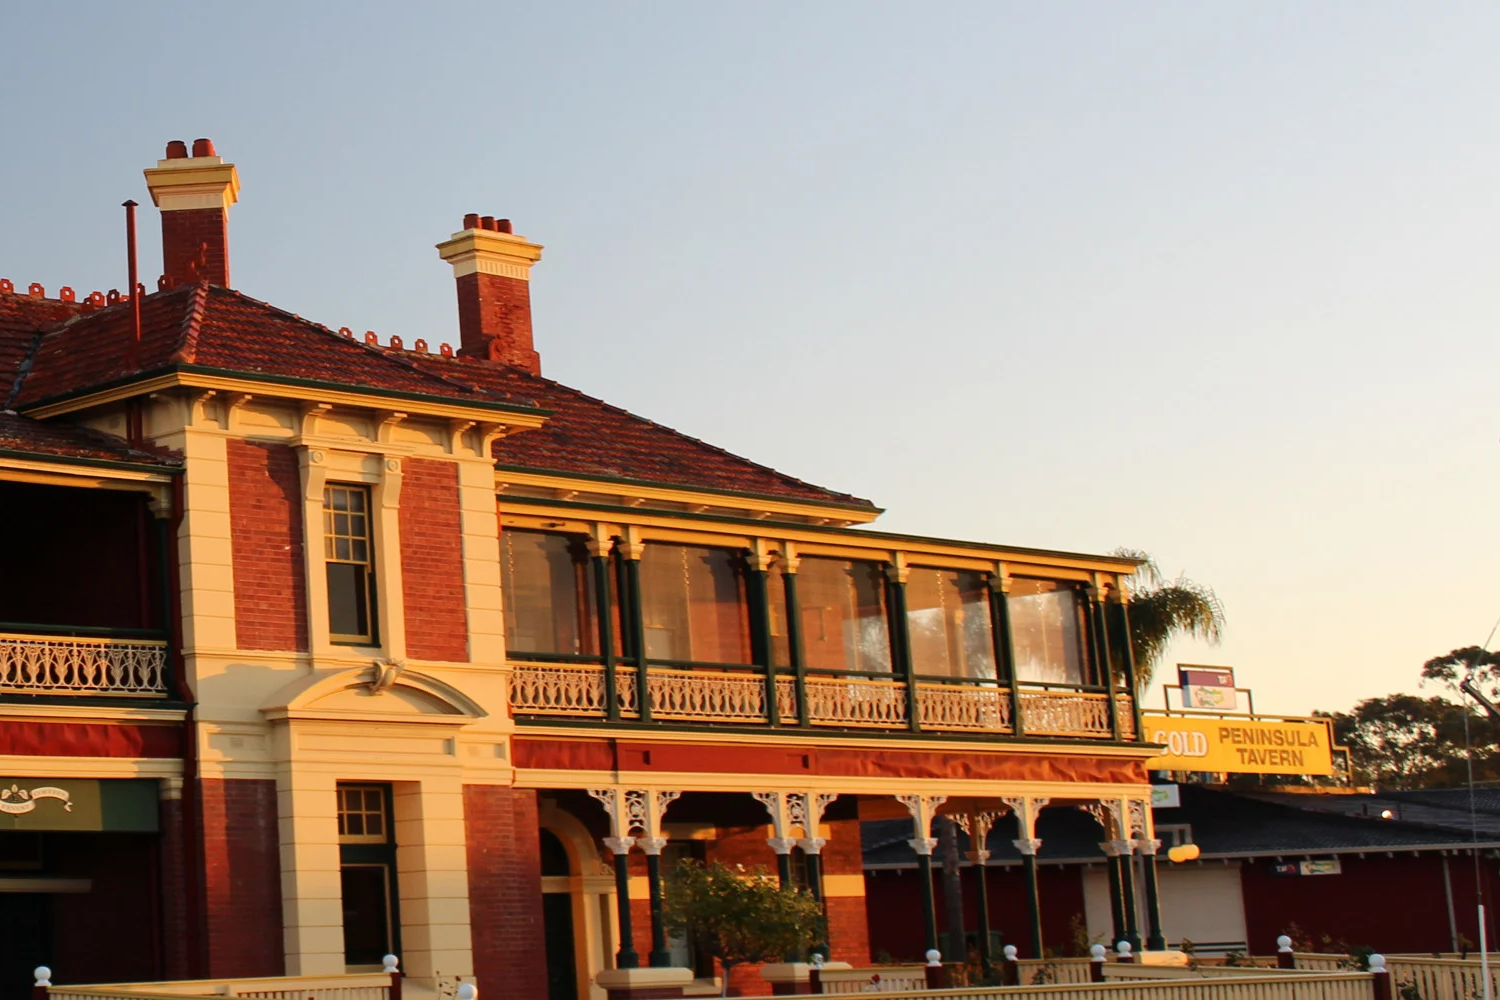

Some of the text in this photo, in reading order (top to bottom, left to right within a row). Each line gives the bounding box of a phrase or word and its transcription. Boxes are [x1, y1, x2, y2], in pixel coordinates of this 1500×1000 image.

[1153, 730, 1207, 757] GOLD
[1218, 727, 1319, 747] PENINSULA
[1236, 748, 1304, 767] TAVERN
